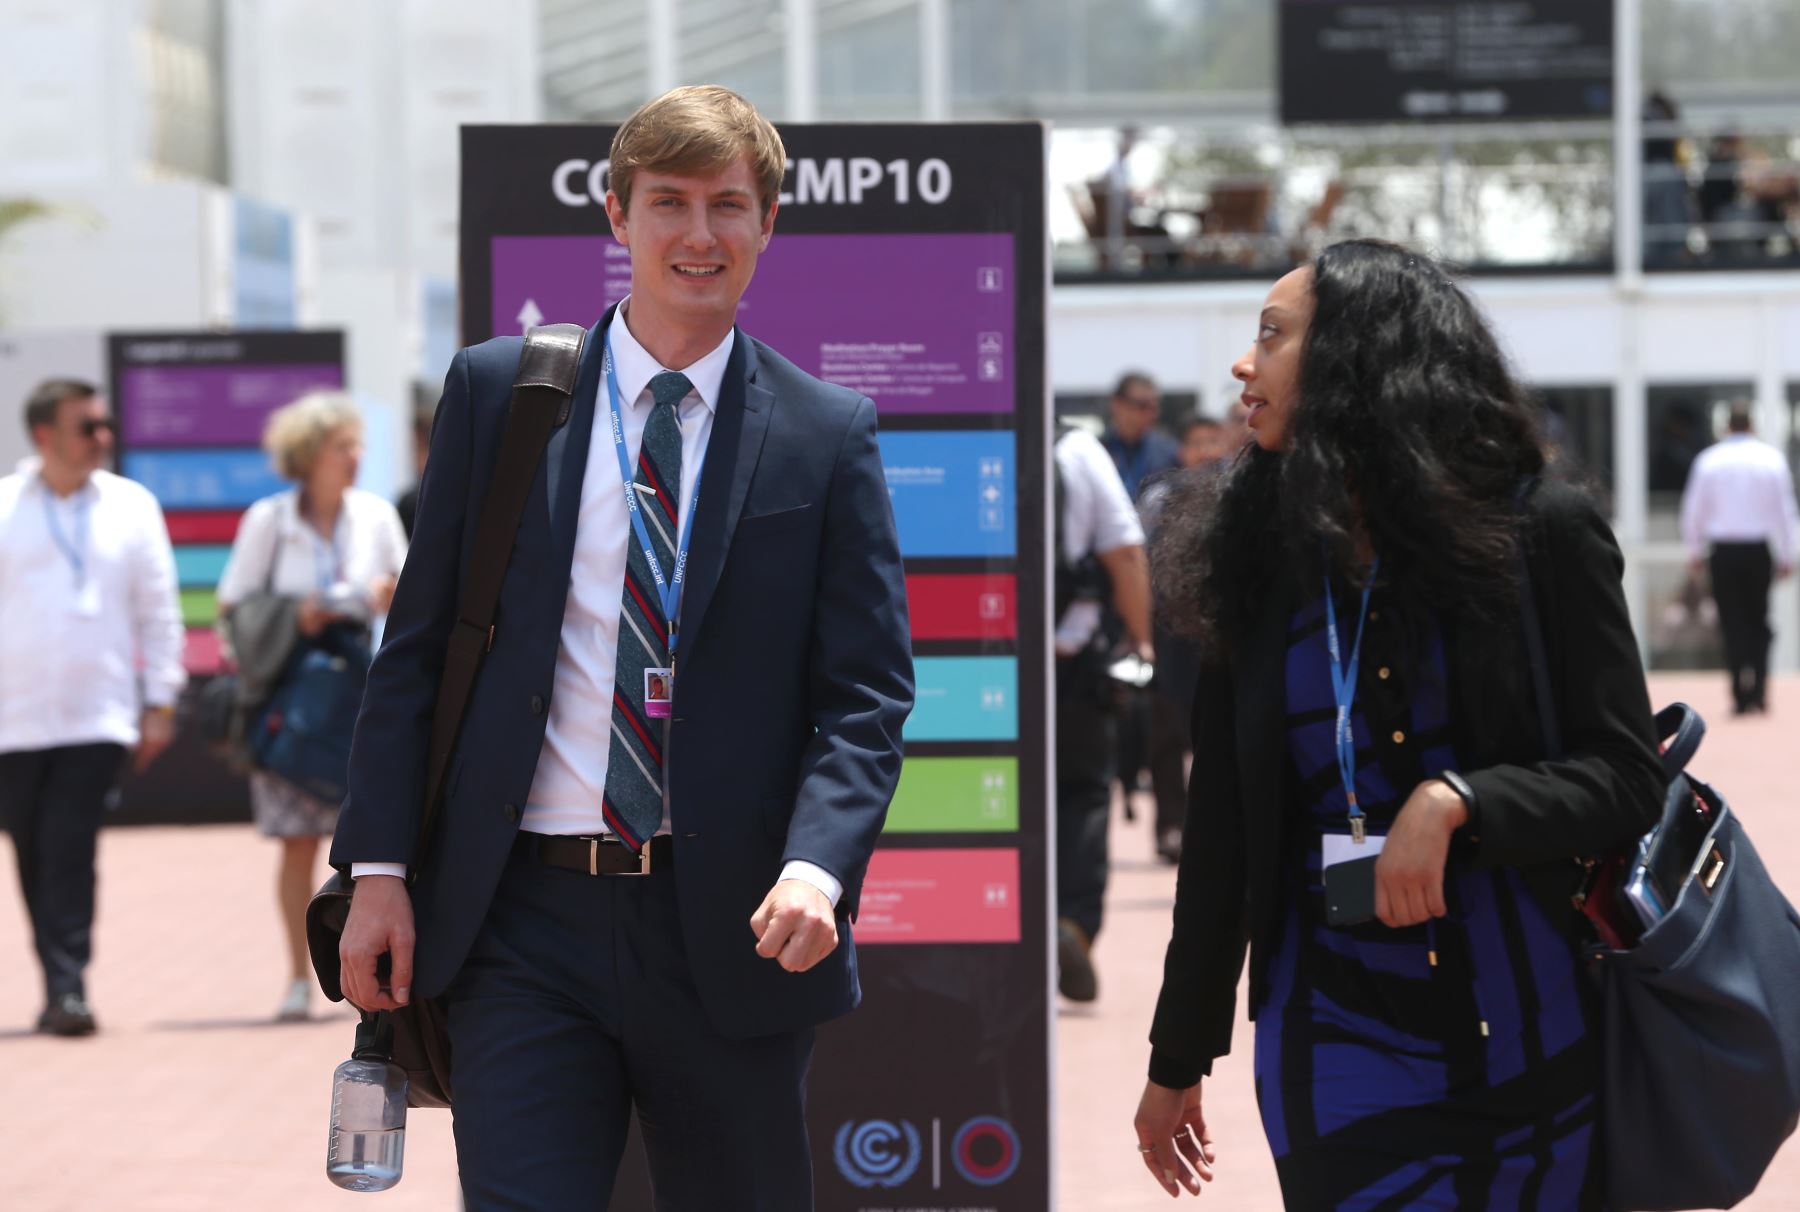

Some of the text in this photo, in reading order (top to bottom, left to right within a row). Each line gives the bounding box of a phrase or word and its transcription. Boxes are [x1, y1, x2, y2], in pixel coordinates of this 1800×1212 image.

[611, 410, 623, 444] unfccc.int
[624, 480, 637, 512] UNFCCC
[645, 549, 664, 585] unfccc.int
[674, 550, 688, 584] UNFCCC
